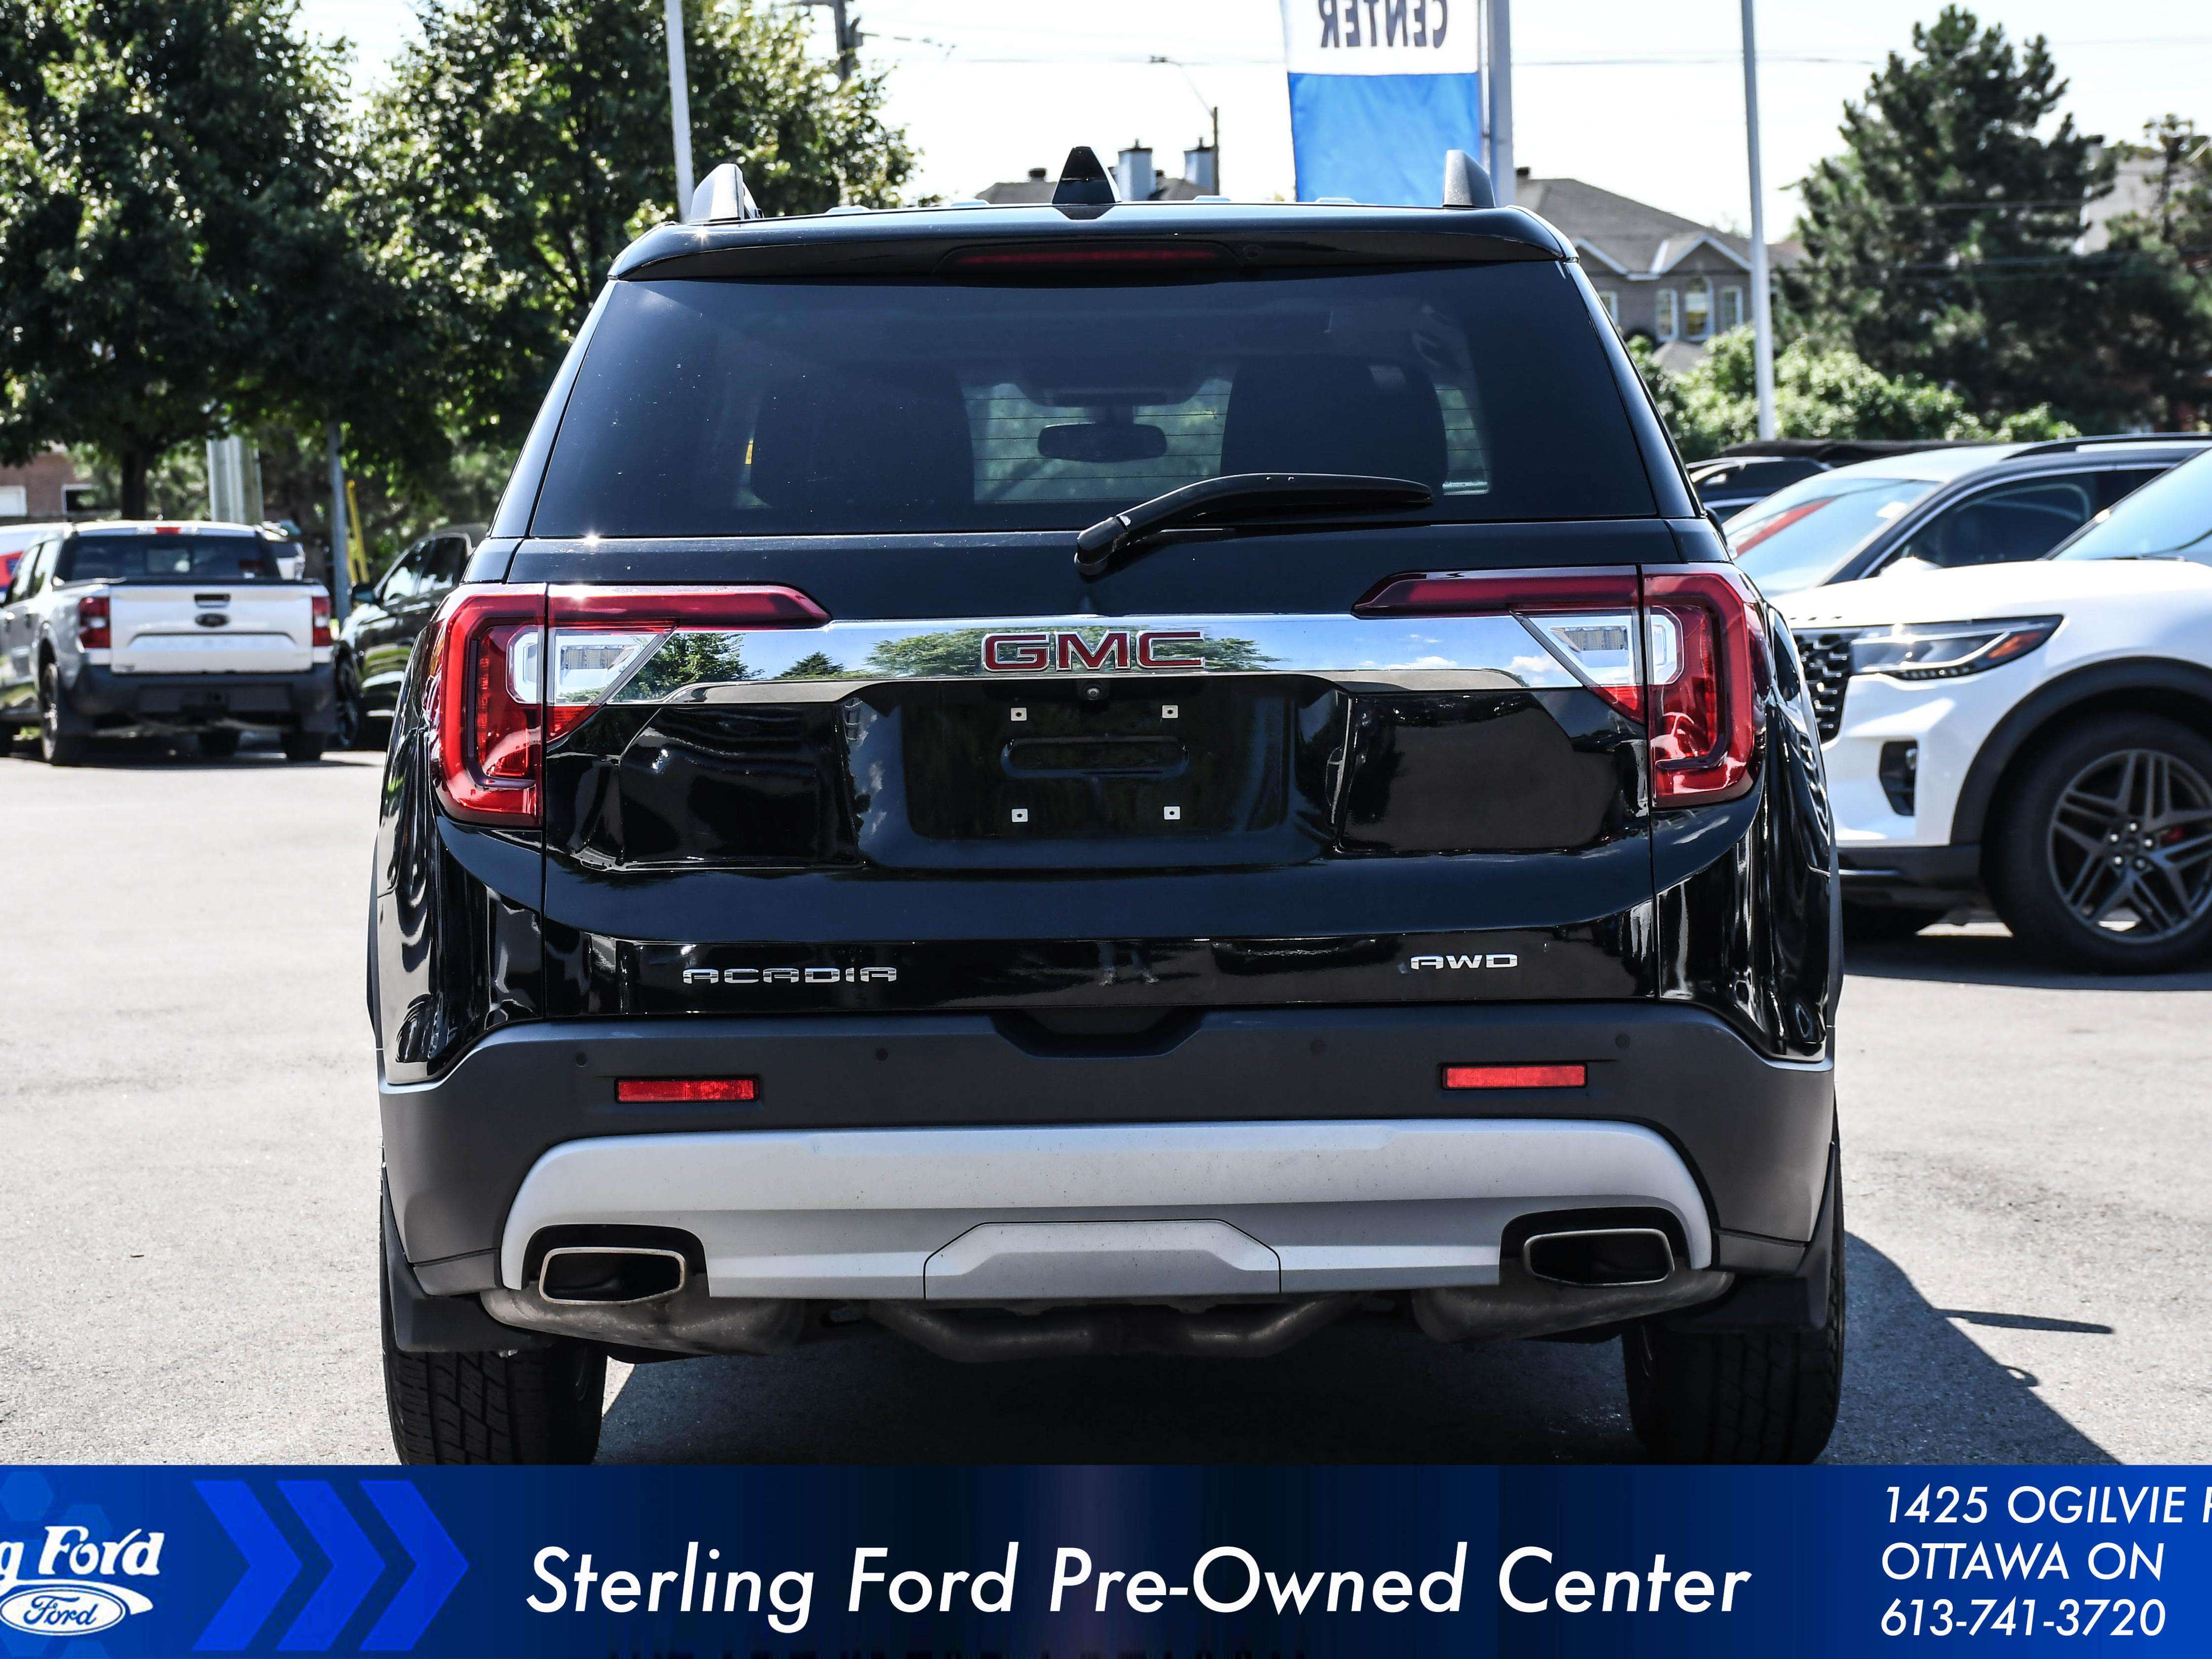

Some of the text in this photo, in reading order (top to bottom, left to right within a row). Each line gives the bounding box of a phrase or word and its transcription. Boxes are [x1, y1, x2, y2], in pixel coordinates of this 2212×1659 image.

[982, 630, 1205, 673] GMC
[1410, 954, 1518, 970] AWD
[683, 967, 897, 983] ACADIA
